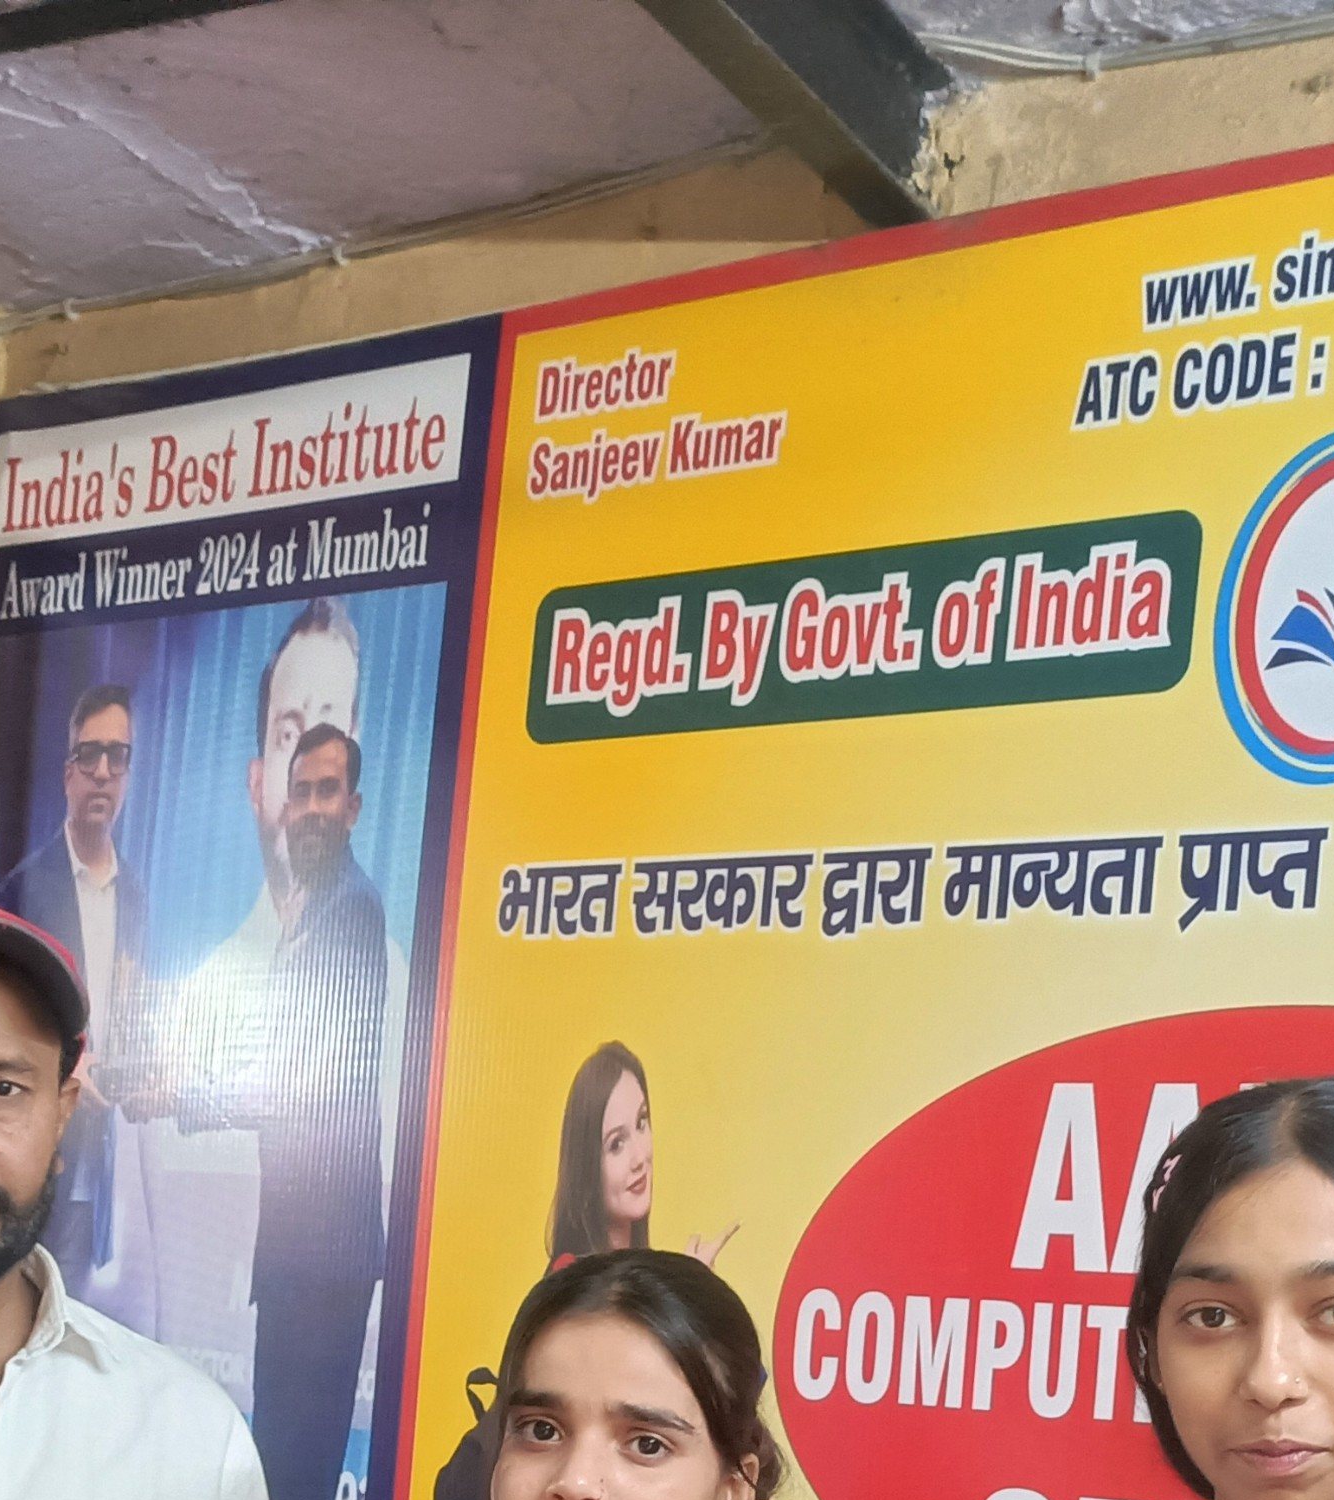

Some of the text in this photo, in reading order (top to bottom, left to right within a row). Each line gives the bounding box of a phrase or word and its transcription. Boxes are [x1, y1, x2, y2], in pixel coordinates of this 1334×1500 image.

[1144, 261, 1257, 325] www.
[537, 352, 675, 419] Director
[1075, 357, 1157, 426] ATC
[1173, 338, 1296, 411] CODE
[1309, 341, 1326, 390] :
[0, 398, 447, 533] India's Best Institute
[528, 412, 784, 502] Sanjeev Kumar
[0, 503, 430, 620] Award Winner 2024 at Mumbai
[549, 552, 1165, 708] Regd. By Govt. of India
[499, 858, 622, 938] भारत
[631, 852, 812, 935] सरकार
[821, 845, 929, 937] द्वारा
[945, 834, 1163, 924] मान्यता
[1176, 825, 1329, 933] प्राप्त
[793, 1289, 1153, 1422] COMPUT
